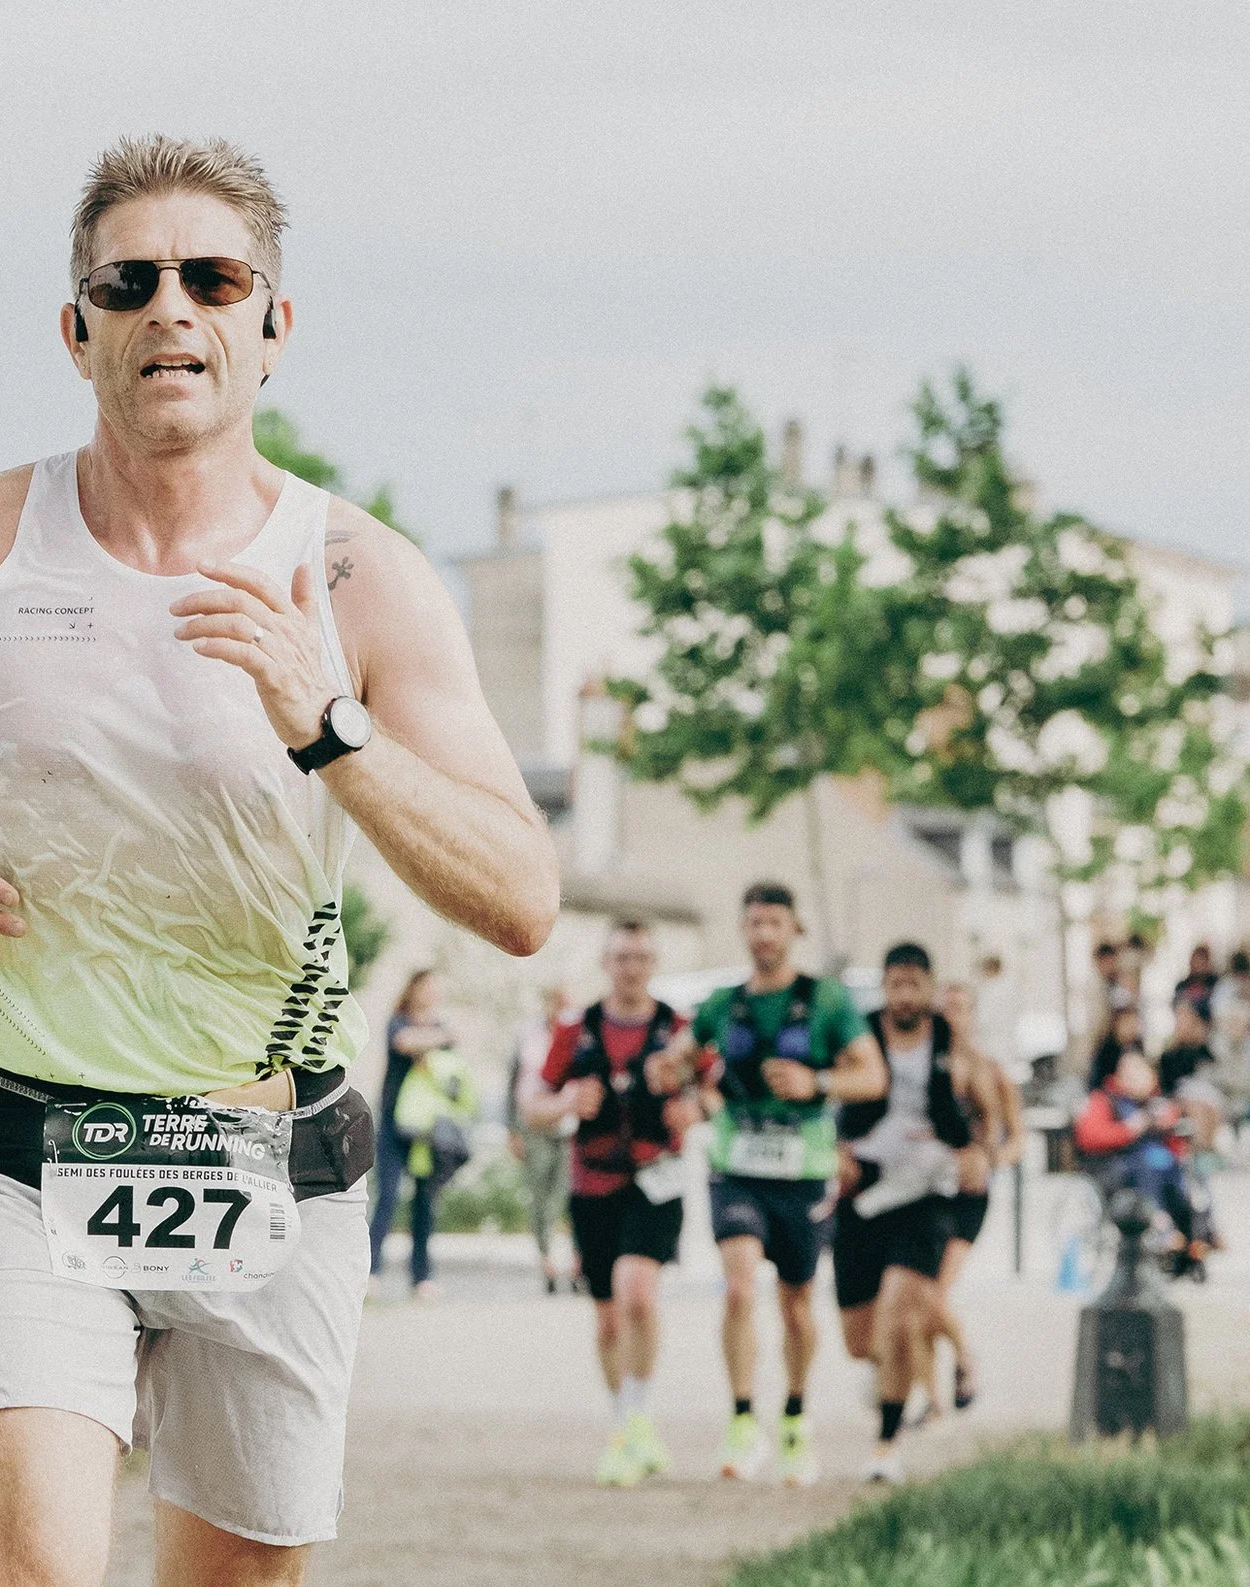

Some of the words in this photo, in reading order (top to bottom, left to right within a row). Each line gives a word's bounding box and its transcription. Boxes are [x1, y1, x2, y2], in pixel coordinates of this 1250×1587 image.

[18, 607, 52, 615] RACING
[54, 607, 94, 615] CONCEPT
[83, 1121, 130, 1144] TDR
[142, 1114, 210, 1133] TERRE
[149, 1135, 171, 1147] DE
[170, 1133, 266, 1161] RUNNING
[57, 1167, 83, 1177] SEMI
[86, 1168, 106, 1178] DES
[109, 1167, 155, 1179] FOULÉES
[158, 1169, 179, 1179] DES
[182, 1170, 223, 1181] BERGES
[226, 1171, 239, 1181] DE
[86, 1184, 253, 1250] 427
